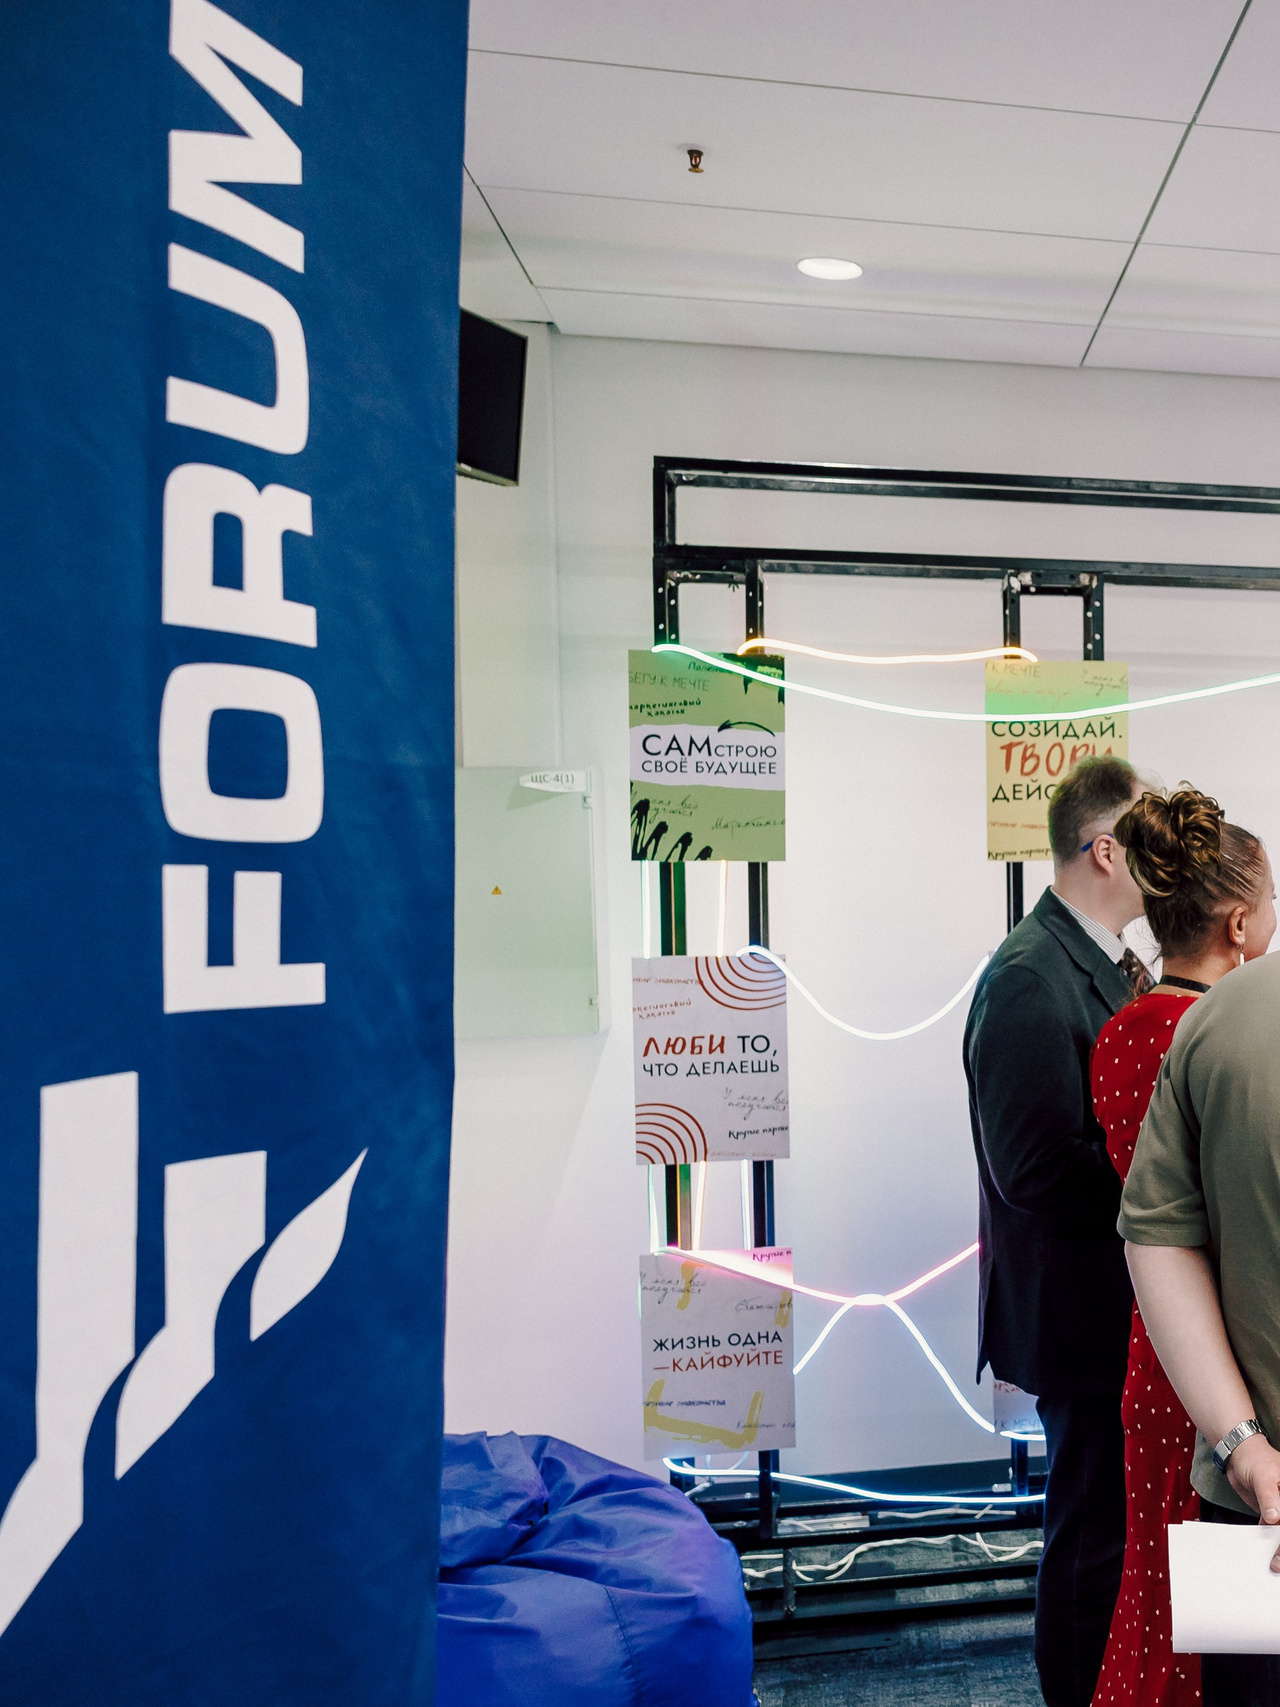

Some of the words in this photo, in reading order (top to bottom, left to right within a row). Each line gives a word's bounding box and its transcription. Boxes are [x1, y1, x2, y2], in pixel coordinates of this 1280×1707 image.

[159, 0, 327, 1015] FORUM
[991, 716, 1123, 740] СОЗИДАЙ.
[641, 757, 689, 774] СВОЁ
[695, 760, 778, 776] БУДУЩЕЕ
[991, 778, 1053, 804] ДЕЙС
[642, 1034, 727, 1058] ЛЮБИ
[736, 1034, 779, 1057] ТО,
[642, 1062, 679, 1077] ЧТО
[685, 1059, 781, 1078] ДЕЛАЕШЬ
[652, 1335, 721, 1353] ЖИЗНЬ
[727, 1329, 783, 1347] ОДНА
